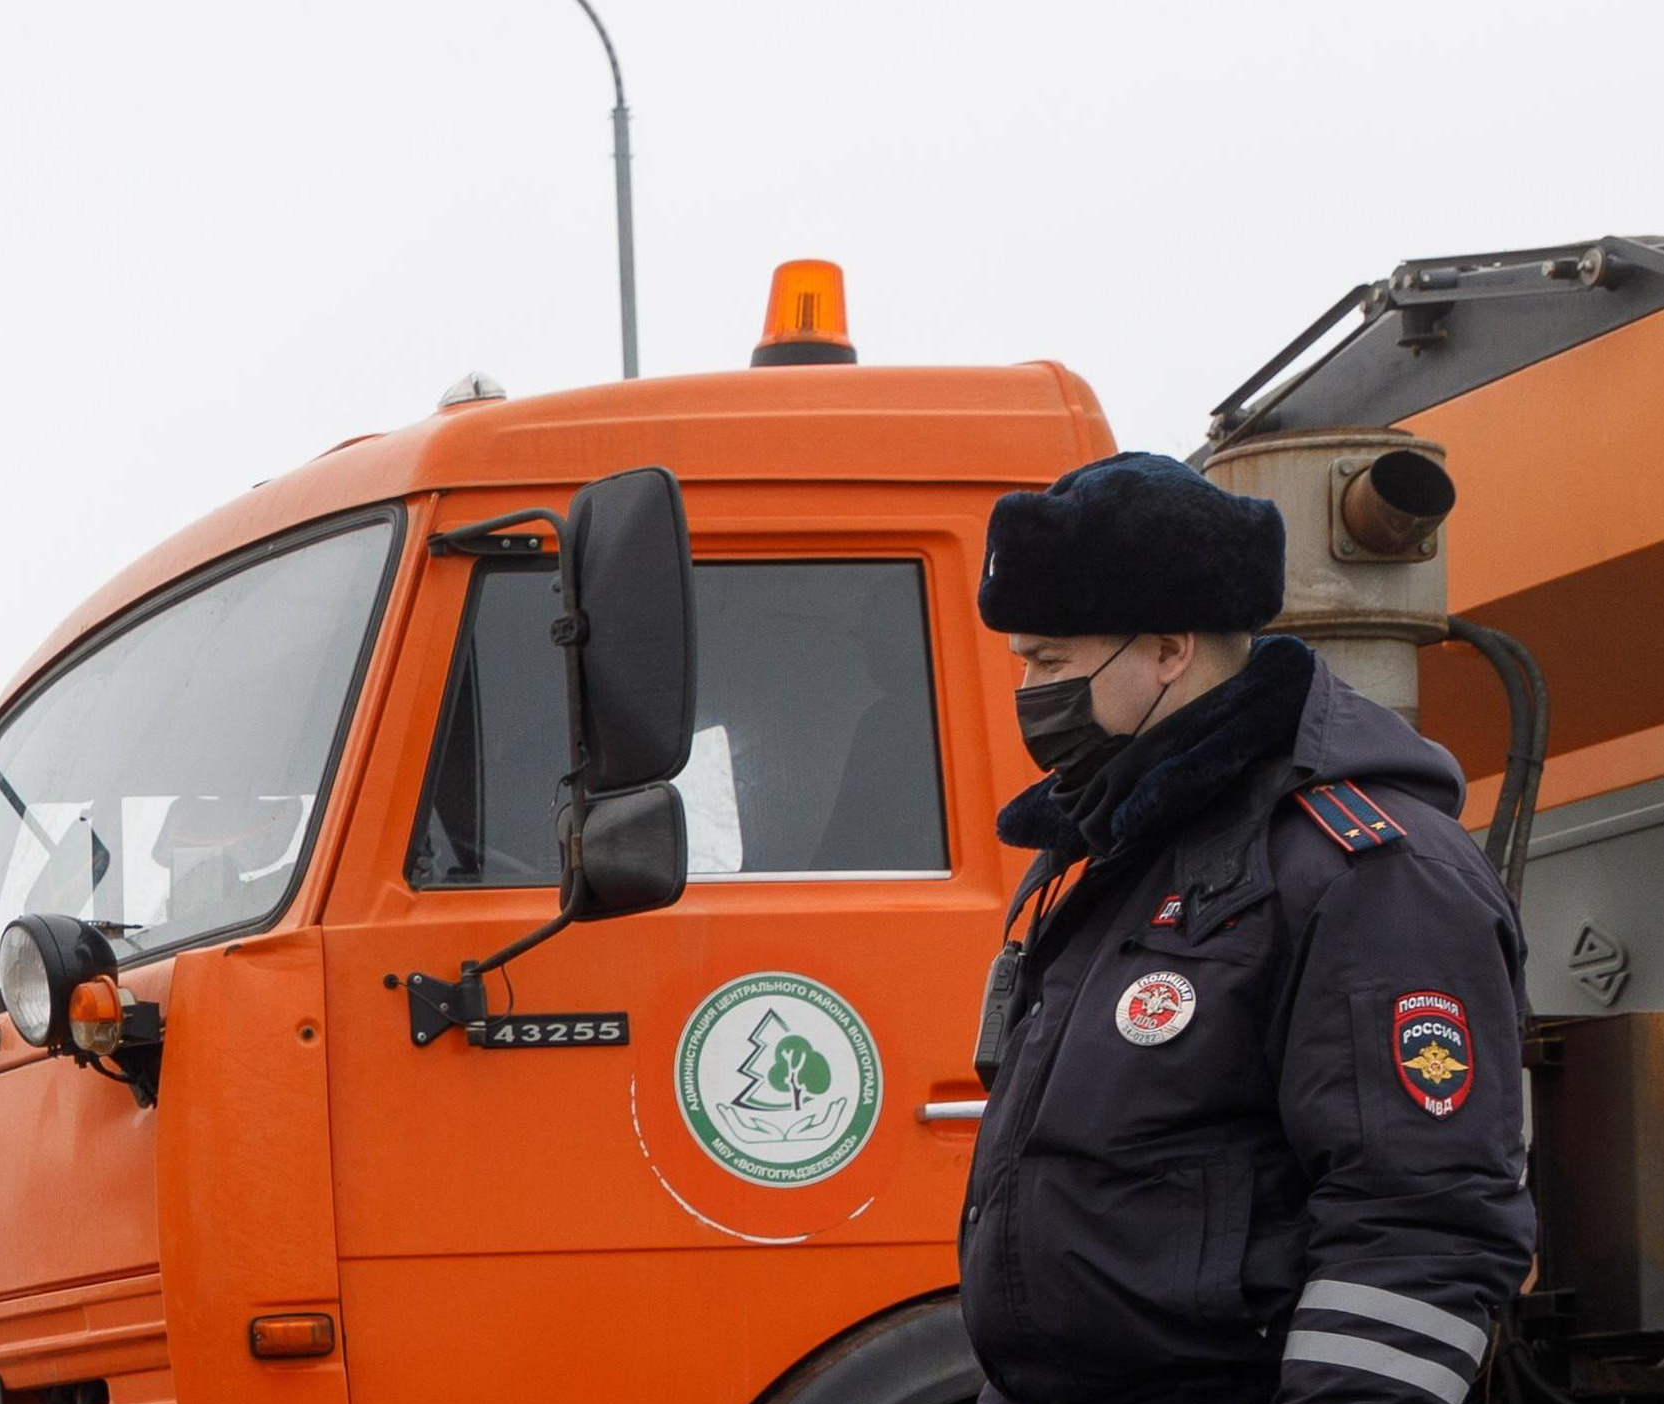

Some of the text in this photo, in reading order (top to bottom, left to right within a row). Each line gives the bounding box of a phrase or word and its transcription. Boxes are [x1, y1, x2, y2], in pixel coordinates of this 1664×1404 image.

[1139, 973, 1193, 1001] ПОЛИЦИЯ
[1399, 996, 1459, 1016] ПОЛИЦИЯ
[494, 1022, 621, 1043] 43255
[1403, 1022, 1462, 1046] РОССИЯ
[682, 981, 876, 1111] АДМИНИСТРАЦИЯ ЦЕНТРАЛЬНОГО РАЙОНА ВОЛГОГРАДА
[1425, 1097, 1453, 1116] МВД
[711, 1134, 858, 1179] МБУ «ВОЛГОГРАДЗЕЛЕНХОЗ»
